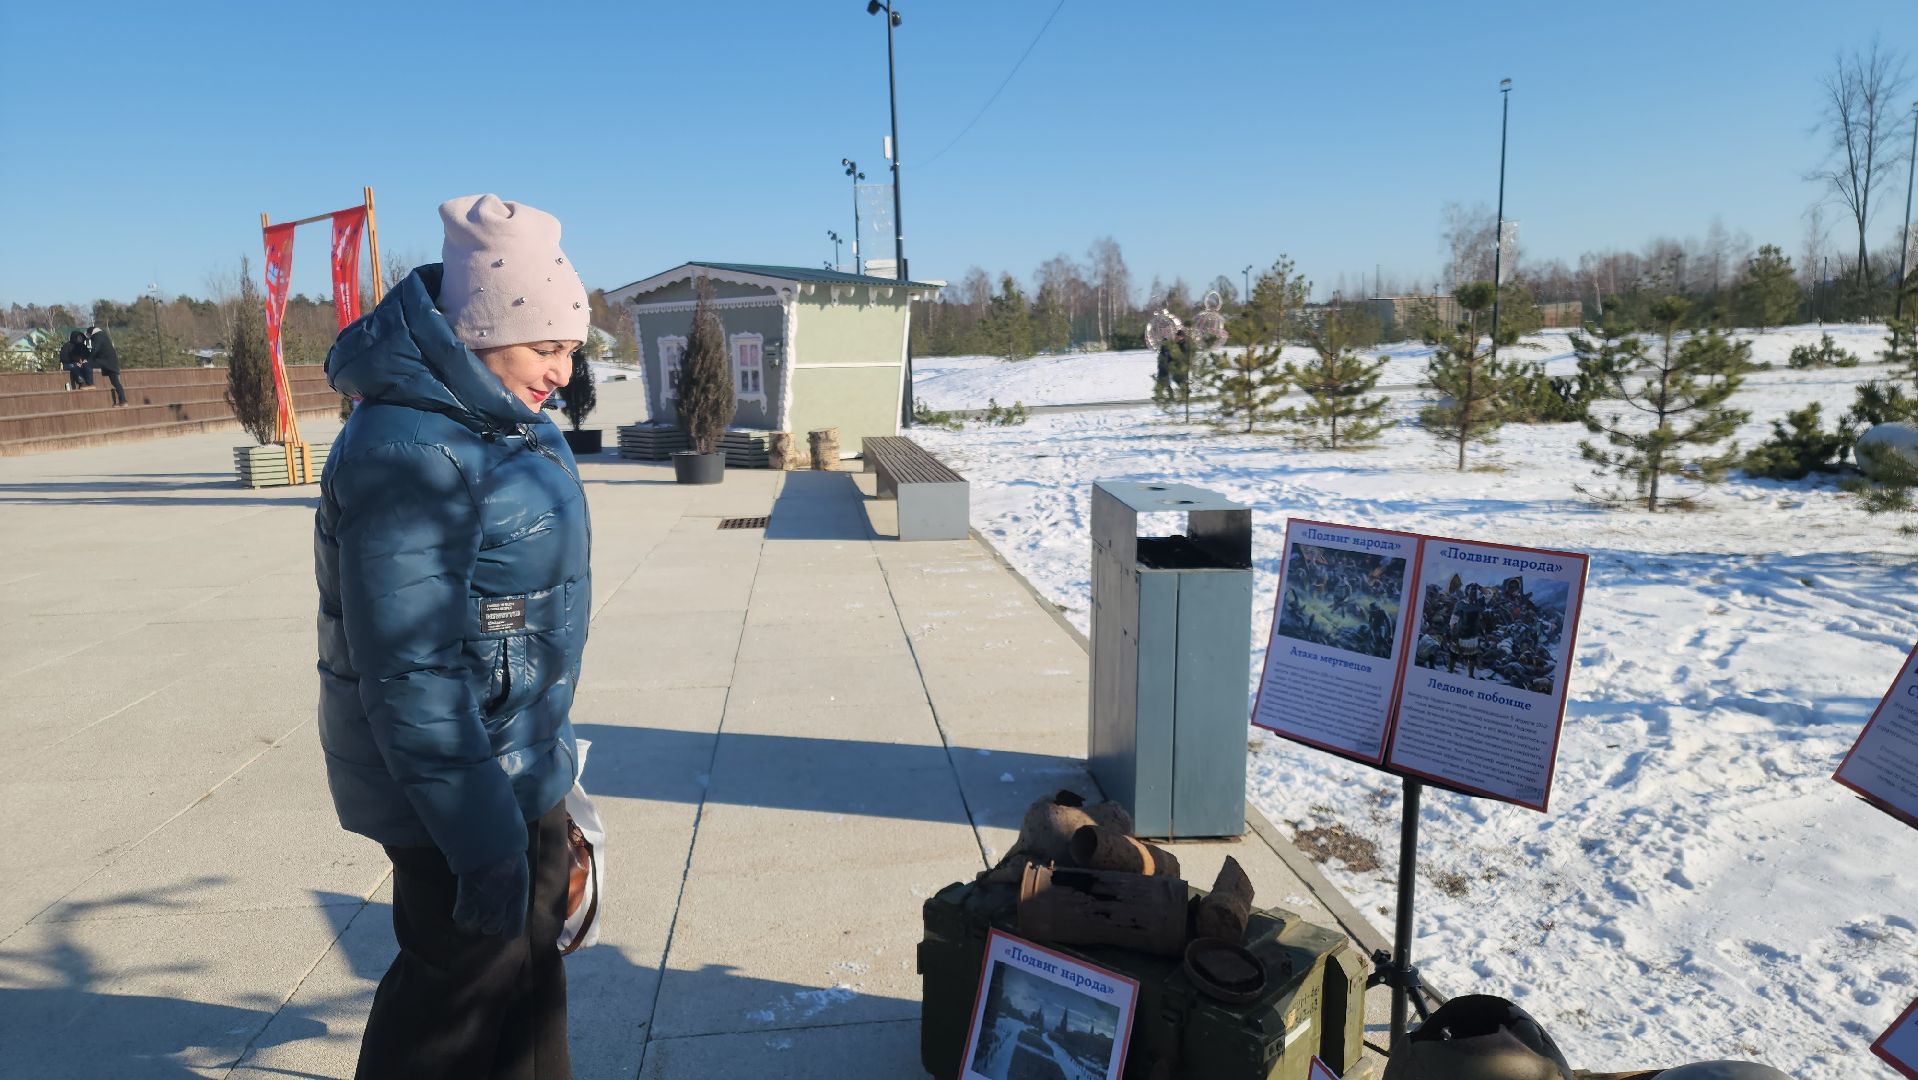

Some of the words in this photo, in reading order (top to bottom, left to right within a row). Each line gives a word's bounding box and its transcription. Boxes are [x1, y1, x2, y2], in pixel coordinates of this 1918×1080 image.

[1301, 528, 1350, 543] «Подвиг
[1352, 539, 1401, 551] народа»
[1440, 547, 1499, 564] «Подвиг
[1502, 557, 1563, 572] народа»
[1290, 646, 1318, 660] Атака
[1320, 655, 1372, 673] мертвецов
[1427, 678, 1475, 698] Ледовое
[1477, 691, 1532, 711] побоище
[1004, 946, 1058, 974] «Подвиг
[1060, 967, 1115, 994] народа»
